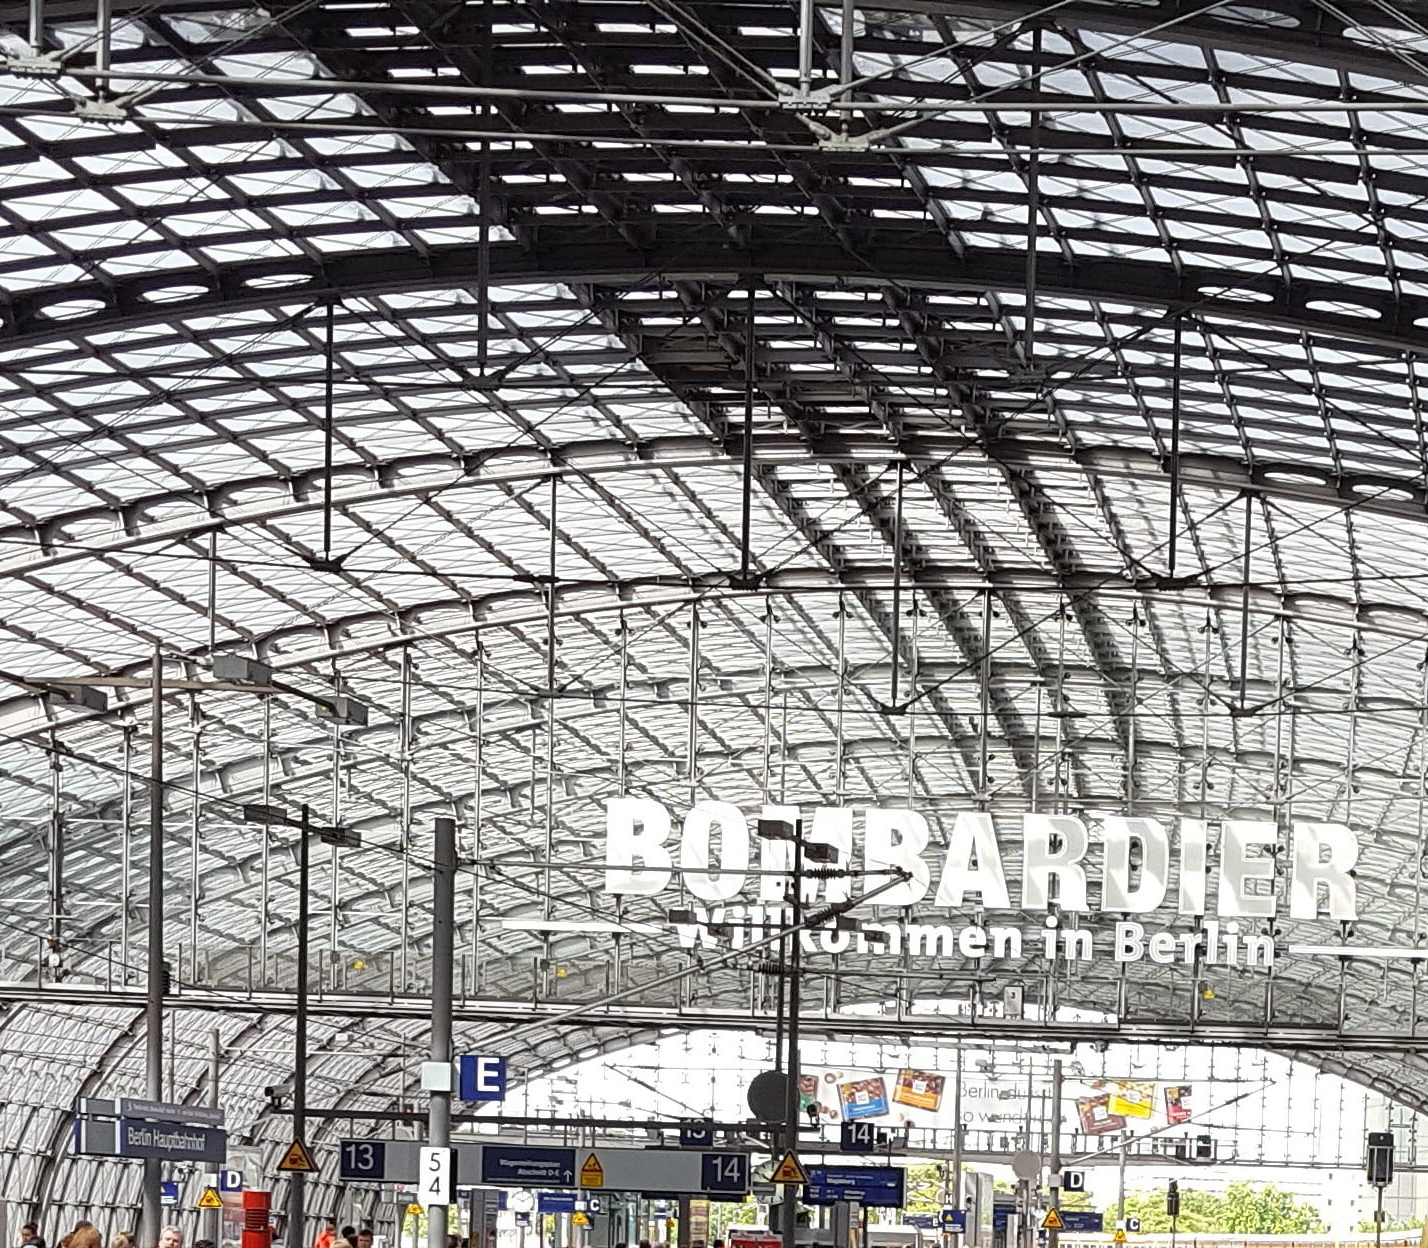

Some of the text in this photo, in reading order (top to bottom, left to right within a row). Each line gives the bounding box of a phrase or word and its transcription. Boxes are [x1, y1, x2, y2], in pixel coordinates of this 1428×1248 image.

[605, 800, 1358, 921] BOMBARDIER
[1041, 915, 1093, 961] in
[1115, 920, 1274, 966] Berlin
[477, 1057, 500, 1092] E
[127, 1126, 206, 1152] Berlin Hauptbahnhof
[848, 1124, 870, 1144] 14
[346, 1143, 374, 1170] 13
[429, 1152, 440, 1172] 5
[226, 1170, 241, 1188] D
[712, 1156, 740, 1182] 14
[429, 1176, 441, 1195] 4
[1070, 1172, 1083, 1188] D
[590, 1199, 599, 1211] C
[1129, 1218, 1139, 1230] C
